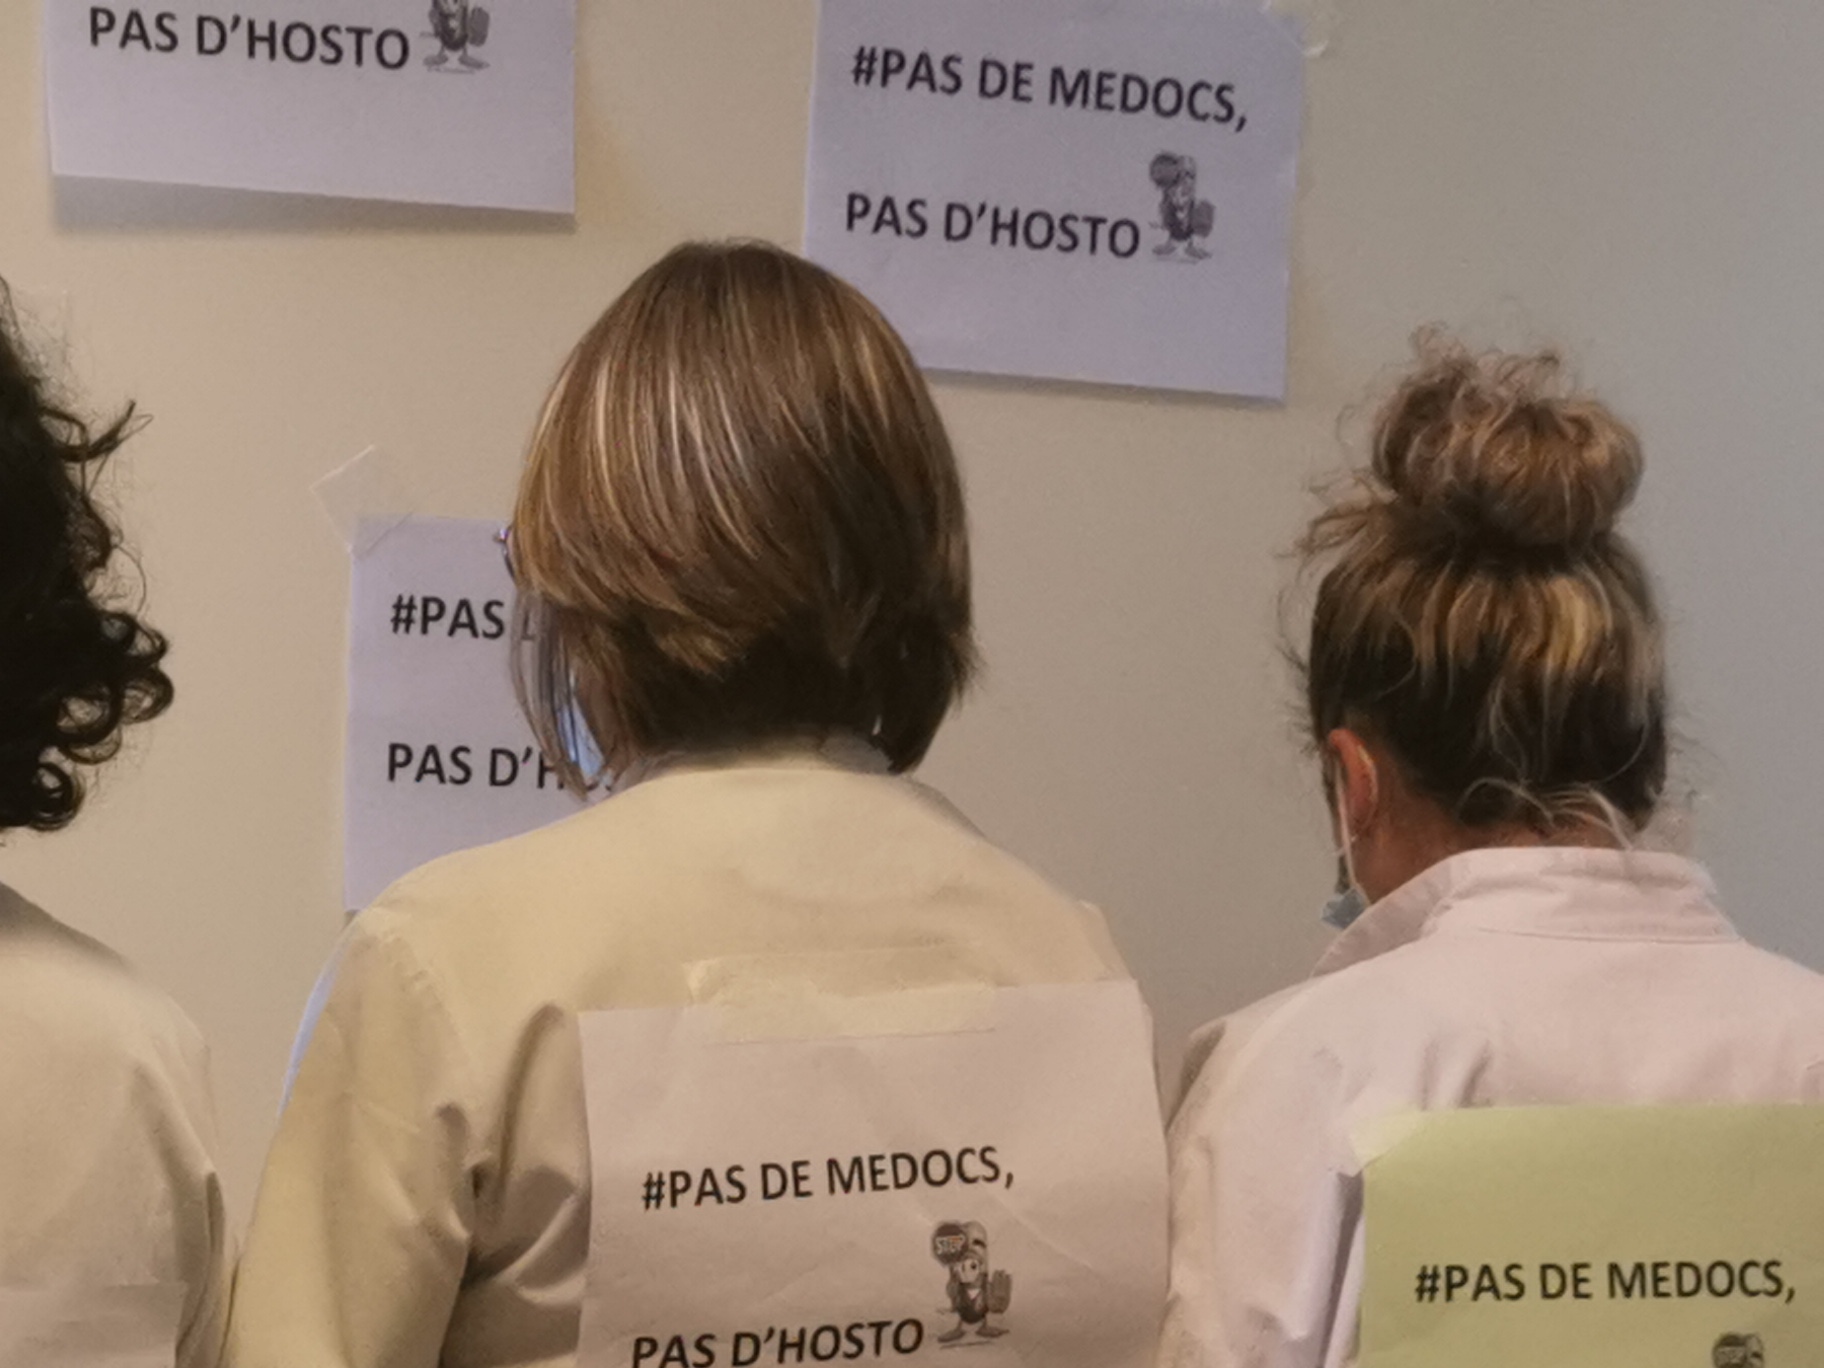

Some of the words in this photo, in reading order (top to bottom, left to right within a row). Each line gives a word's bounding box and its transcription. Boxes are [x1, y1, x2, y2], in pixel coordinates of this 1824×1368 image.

[90, 7, 179, 53] PAS
[197, 15, 410, 70] D'HOSTO
[853, 46, 962, 95] #PAS
[979, 59, 1033, 102] DE
[1049, 67, 1247, 132] MEDOCS,
[846, 192, 928, 238] PAS
[944, 202, 1140, 258] D'HOSTO
[391, 595, 505, 640] #PAS
[388, 743, 472, 785] PAS
[642, 1165, 747, 1210] #PAS
[761, 1160, 813, 1200] DE
[826, 1146, 1013, 1195] MEDOCS,
[1415, 1263, 1525, 1302] #PAS
[1540, 1262, 1592, 1300] DE
[1608, 1260, 1795, 1303] MEDOCS,
[731, 1318, 924, 1368] D'HOSTO
